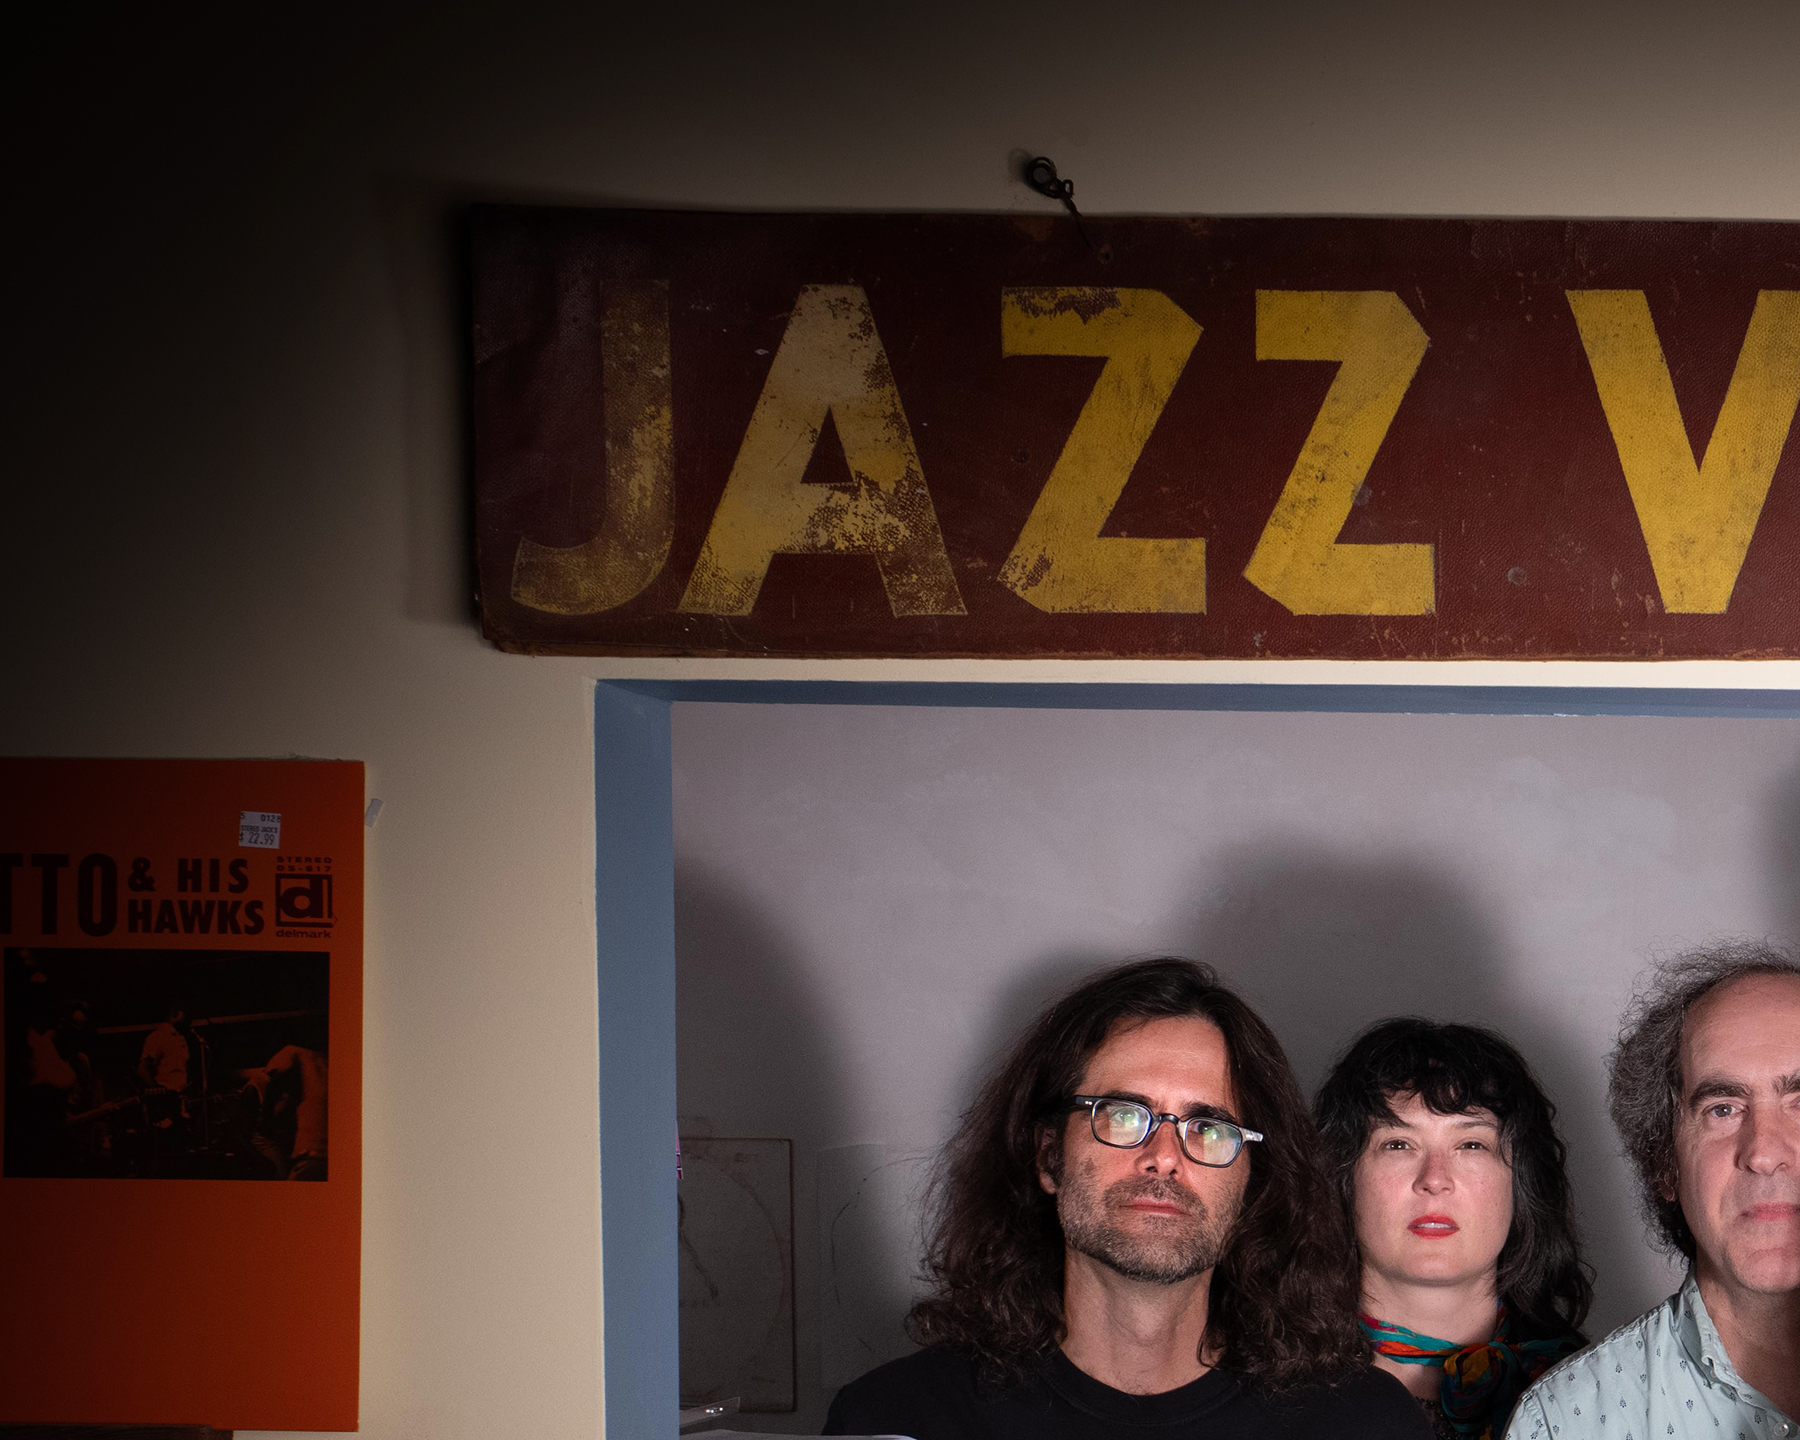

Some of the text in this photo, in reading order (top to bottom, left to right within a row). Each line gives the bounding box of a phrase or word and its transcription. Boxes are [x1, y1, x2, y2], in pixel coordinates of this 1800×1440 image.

[510, 278, 1436, 616] JAZZ
[249, 832, 275, 846] 22.99
[276, 856, 332, 864] STEREO
[276, 864, 332, 872] DS-617
[127, 857, 156, 893] &
[177, 857, 250, 894] HIS
[127, 899, 266, 936] HAWKS
[275, 929, 332, 939] delmark
